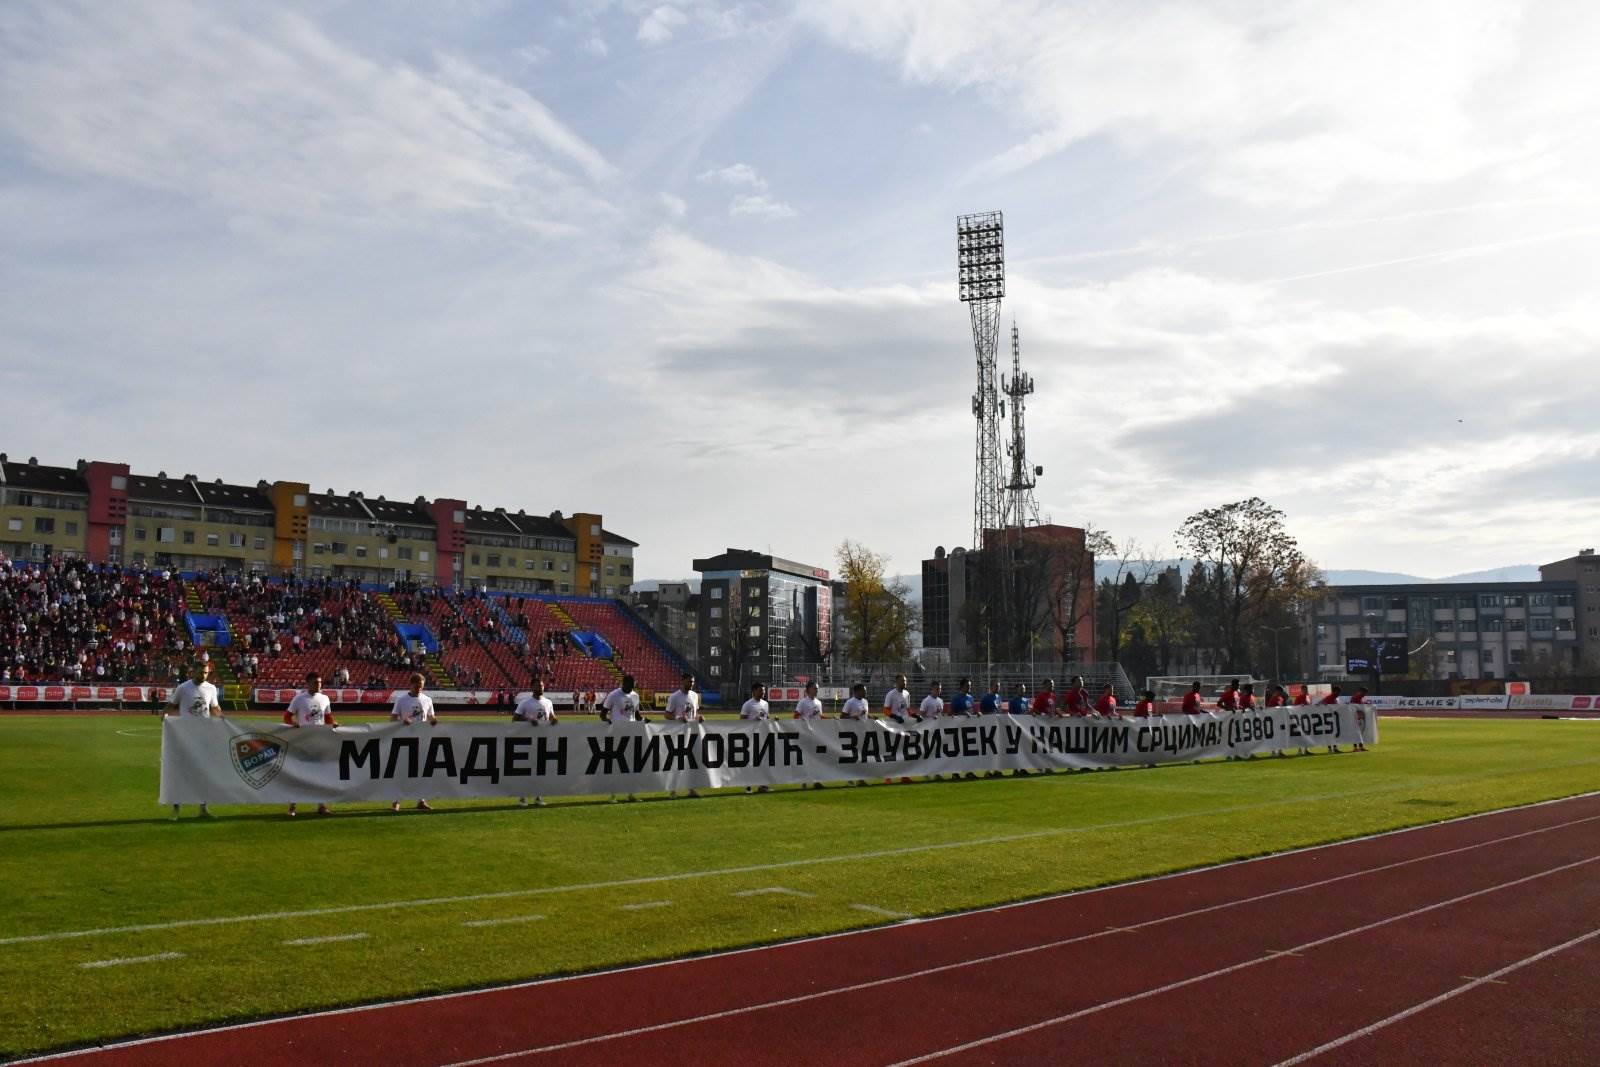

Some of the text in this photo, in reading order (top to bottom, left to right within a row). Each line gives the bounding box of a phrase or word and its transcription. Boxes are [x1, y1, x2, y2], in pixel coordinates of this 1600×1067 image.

[1398, 699, 1443, 707] KELME
[339, 736, 568, 785] МЛАДЕН
[585, 732, 804, 776] ЖИЖОВИЋ
[838, 725, 998, 764] ЗАУВИЈЕК
[1005, 725, 1022, 754] У
[1031, 726, 1129, 754] НАШИМ
[1136, 721, 1223, 755] СРЦИМА!
[1227, 716, 1274, 748] (1980
[1289, 711, 1341, 739] 2025)
